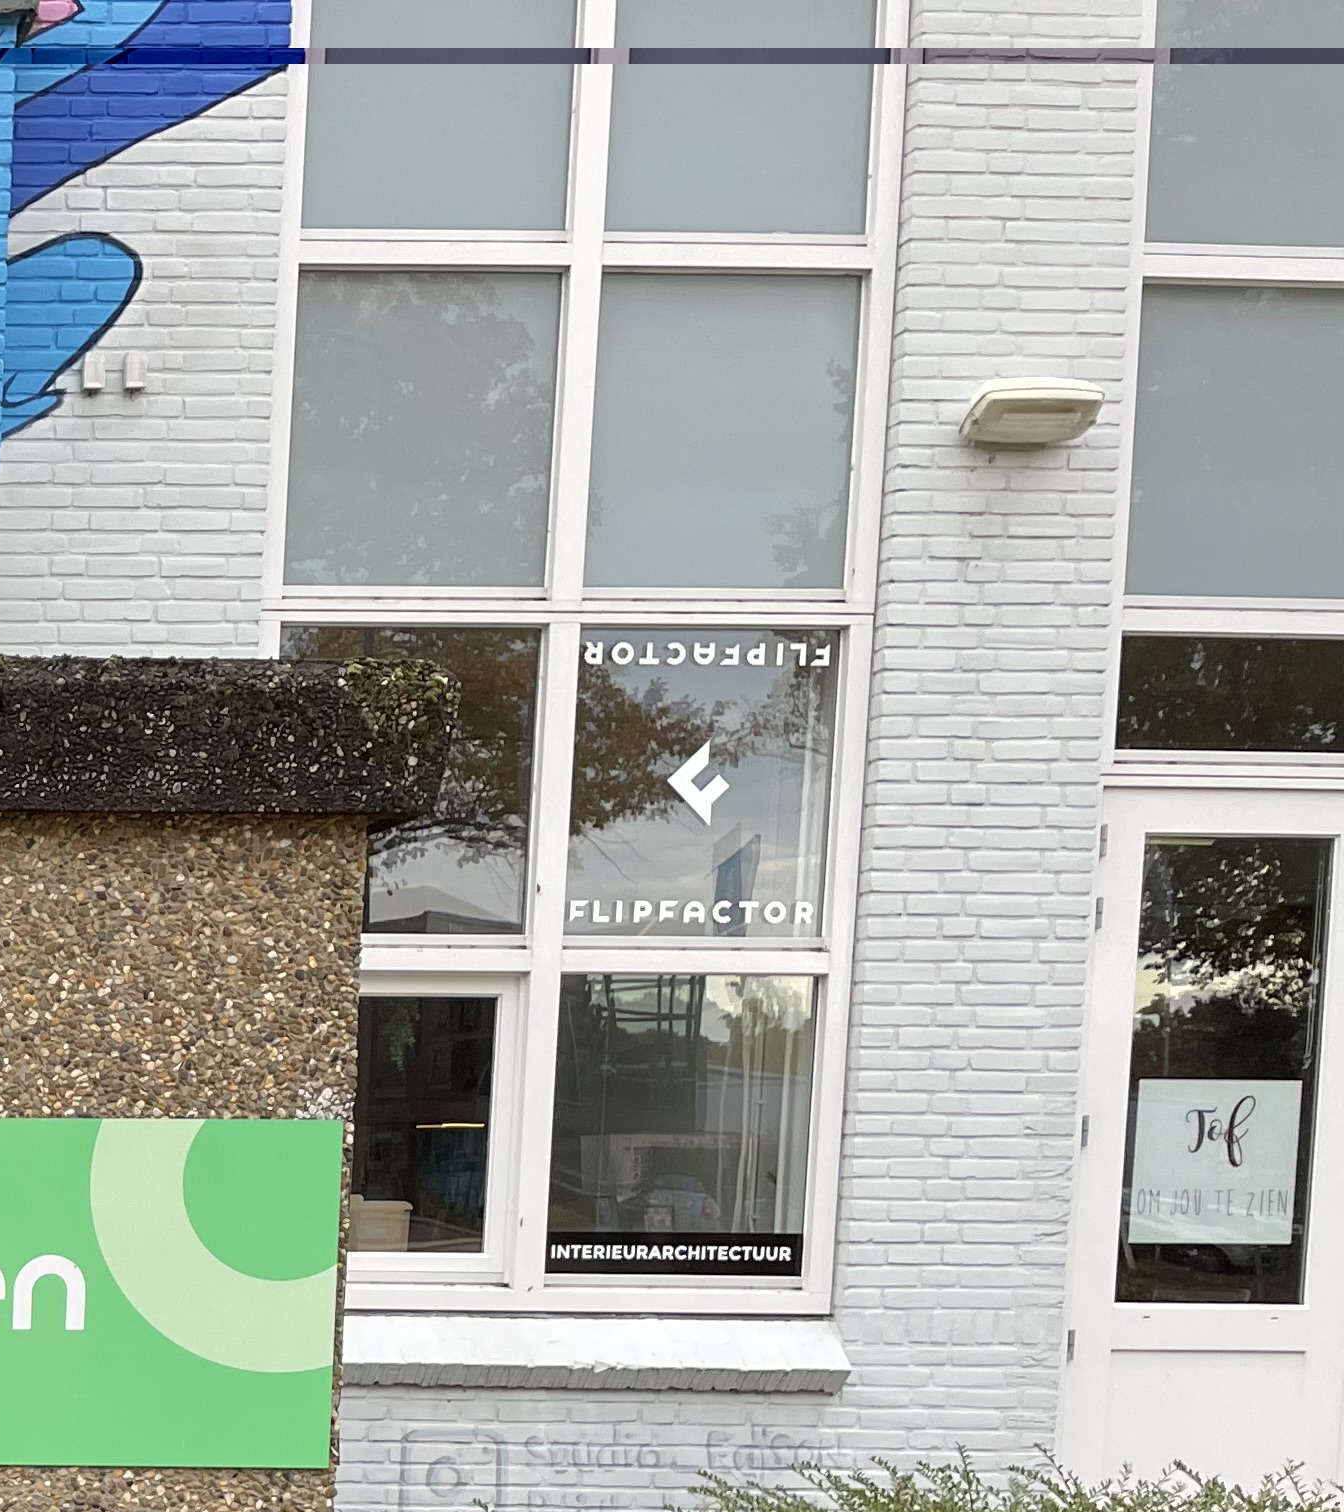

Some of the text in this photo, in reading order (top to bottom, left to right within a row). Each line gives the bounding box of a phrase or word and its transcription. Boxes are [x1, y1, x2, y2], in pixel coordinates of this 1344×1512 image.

[584, 641, 831, 667] FLIPFACTOR
[568, 900, 814, 924] FLIPFACTOR
[1185, 1095, 1257, 1167] Tof
[1136, 1188, 1289, 1217] OM JOU TE ZIEN
[550, 1243, 792, 1262] INTERIEURARCHITECTUUR
